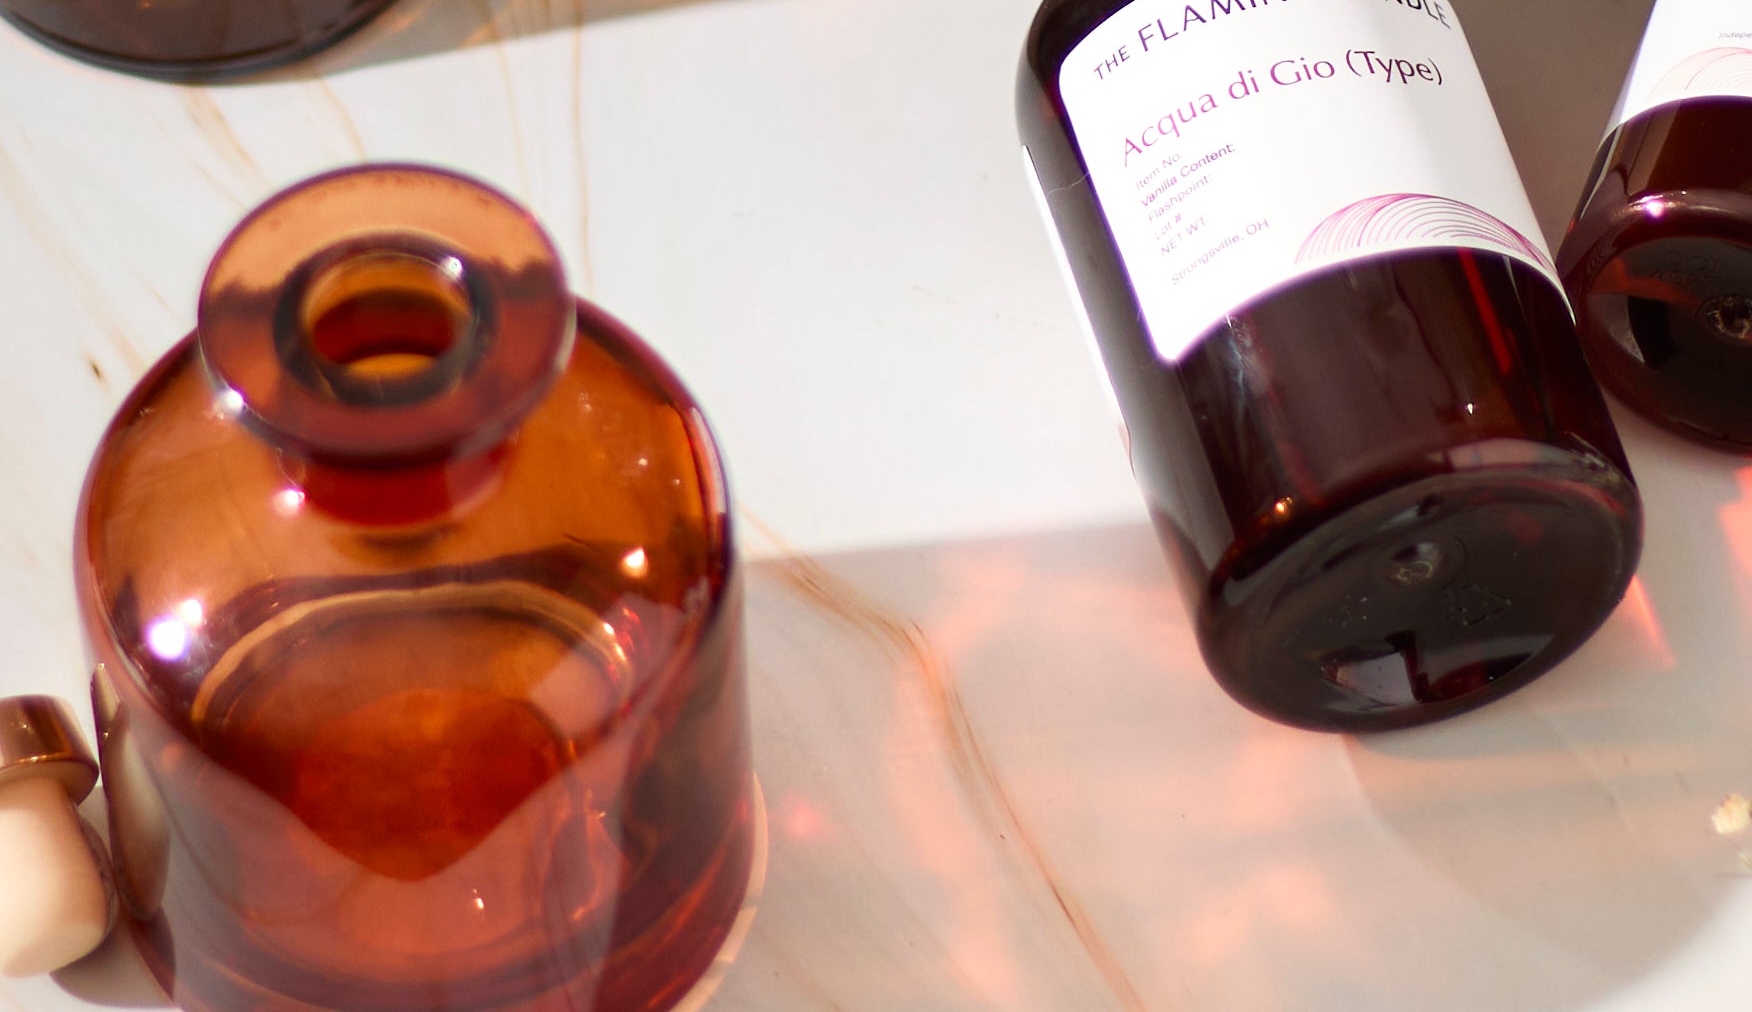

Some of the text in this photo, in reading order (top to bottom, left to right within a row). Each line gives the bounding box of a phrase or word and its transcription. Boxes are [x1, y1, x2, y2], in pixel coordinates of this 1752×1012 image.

[1094, 45, 1130, 80] THE
[1125, 49, 1442, 167] Acqua di Gio (Type)
[1140, 176, 1178, 207] Vanilla
[1246, 218, 1269, 236] OH
